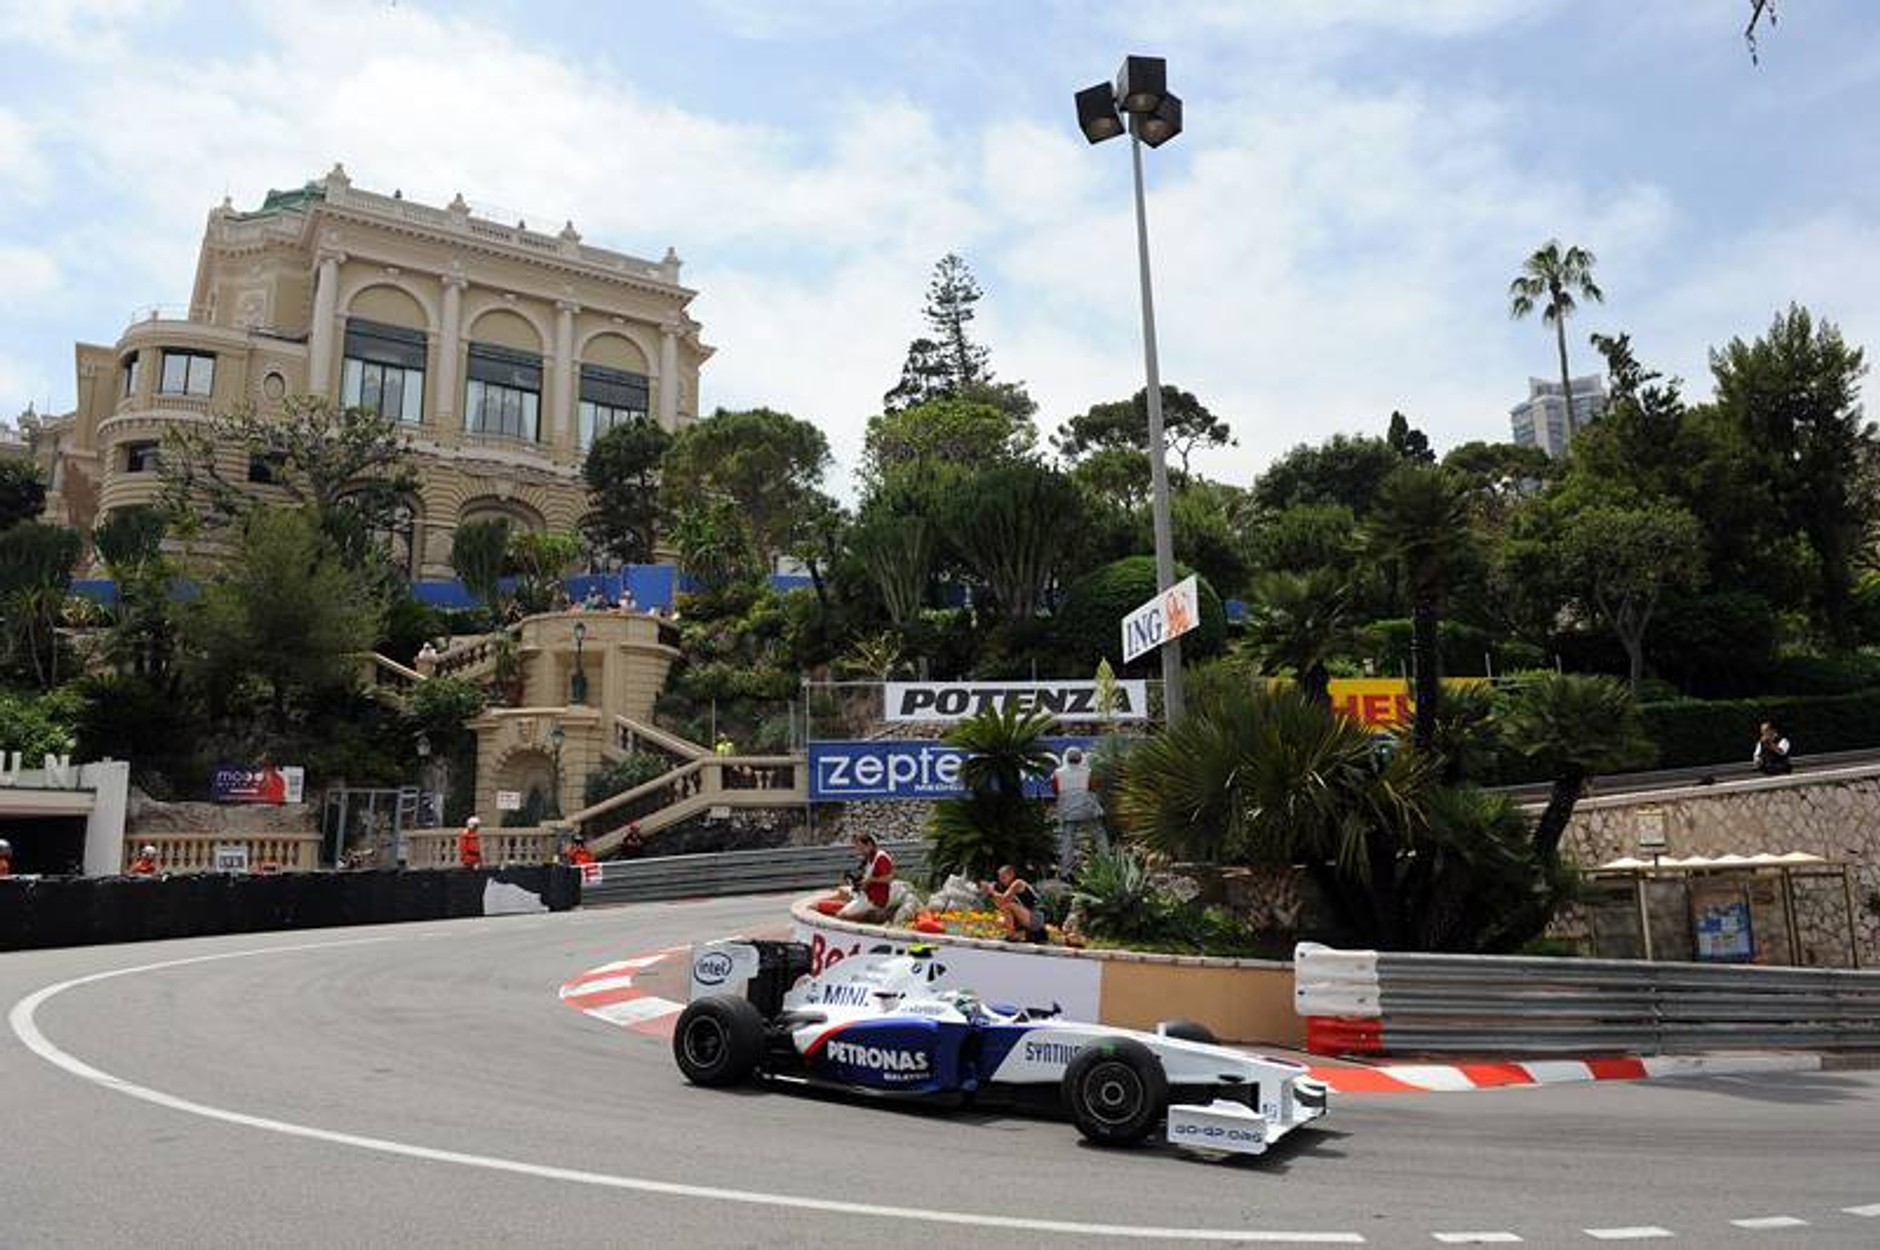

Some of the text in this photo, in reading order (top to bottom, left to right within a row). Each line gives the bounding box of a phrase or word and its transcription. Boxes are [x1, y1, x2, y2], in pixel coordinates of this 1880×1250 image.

[1128, 608, 1162, 656] ING
[900, 688, 1133, 715] POTENZA
[819, 747, 985, 791] zepte
[827, 1040, 930, 1071] PETRONAS
